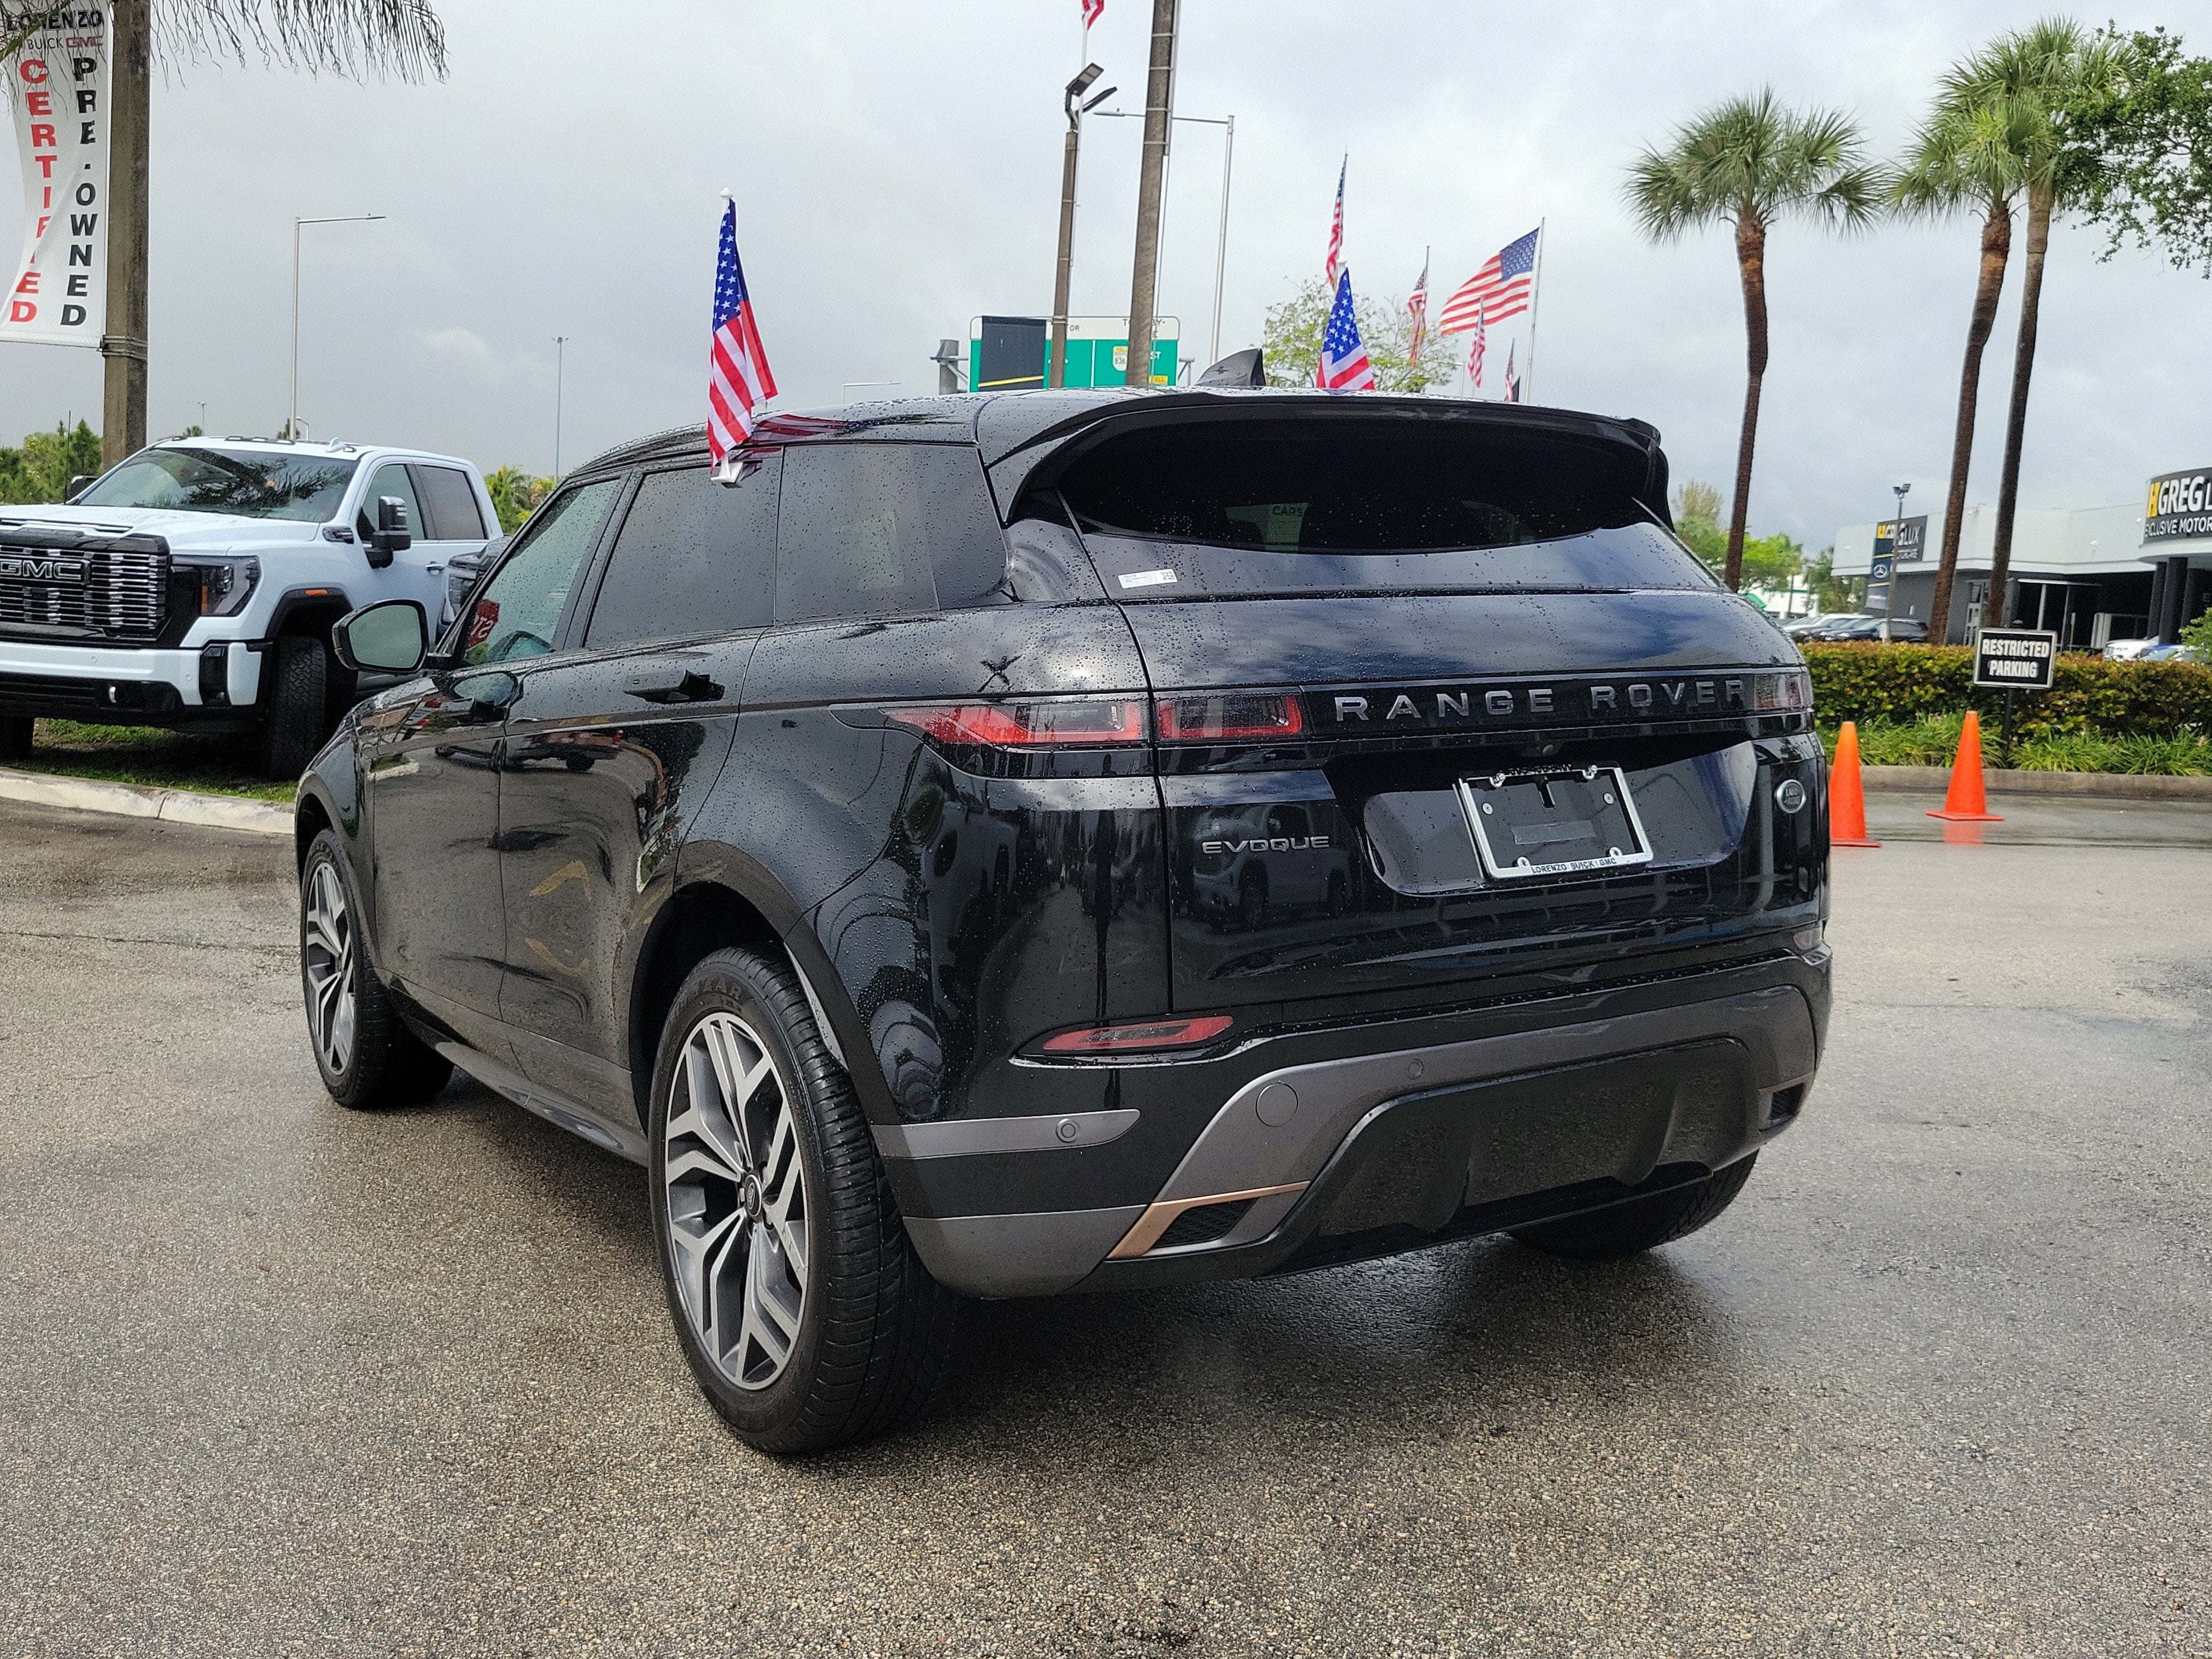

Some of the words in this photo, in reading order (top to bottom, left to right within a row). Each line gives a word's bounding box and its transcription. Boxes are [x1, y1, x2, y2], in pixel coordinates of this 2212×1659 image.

[7, 9, 103, 31] LOENZO
[28, 37, 64, 50] BUICK
[0, 559, 82, 580] GMC
[1982, 638, 2050, 658] RESTRICTED
[1988, 659, 2039, 678] PARKING
[1334, 689, 1554, 721] RANGE
[1590, 679, 1746, 709] ROVER
[1201, 836, 1330, 854] EVOQUE
[1532, 863, 1567, 874] LORENZO
[1570, 860, 1595, 870] BUICK
[1599, 857, 1617, 866] GMC
